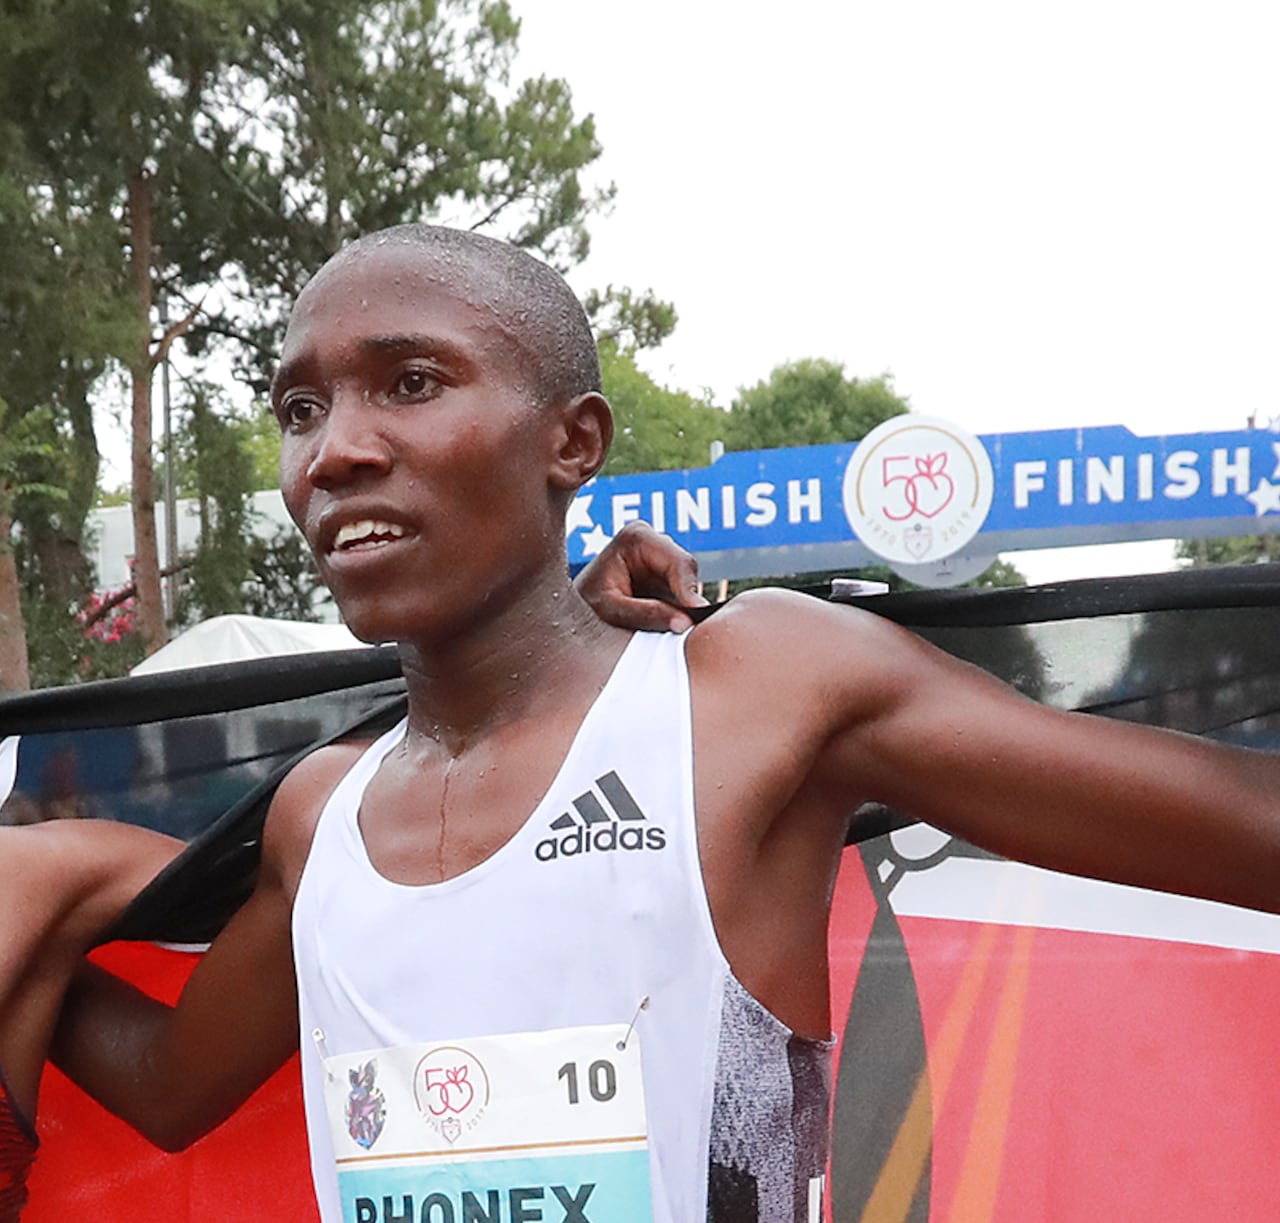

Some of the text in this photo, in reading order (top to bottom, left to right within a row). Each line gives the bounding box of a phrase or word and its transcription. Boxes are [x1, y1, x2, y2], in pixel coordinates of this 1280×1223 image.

[1013, 447, 1251, 509] FINISH
[611, 478, 822, 535] FINISH
[535, 821, 667, 861] adidas
[557, 1059, 618, 1104] 10
